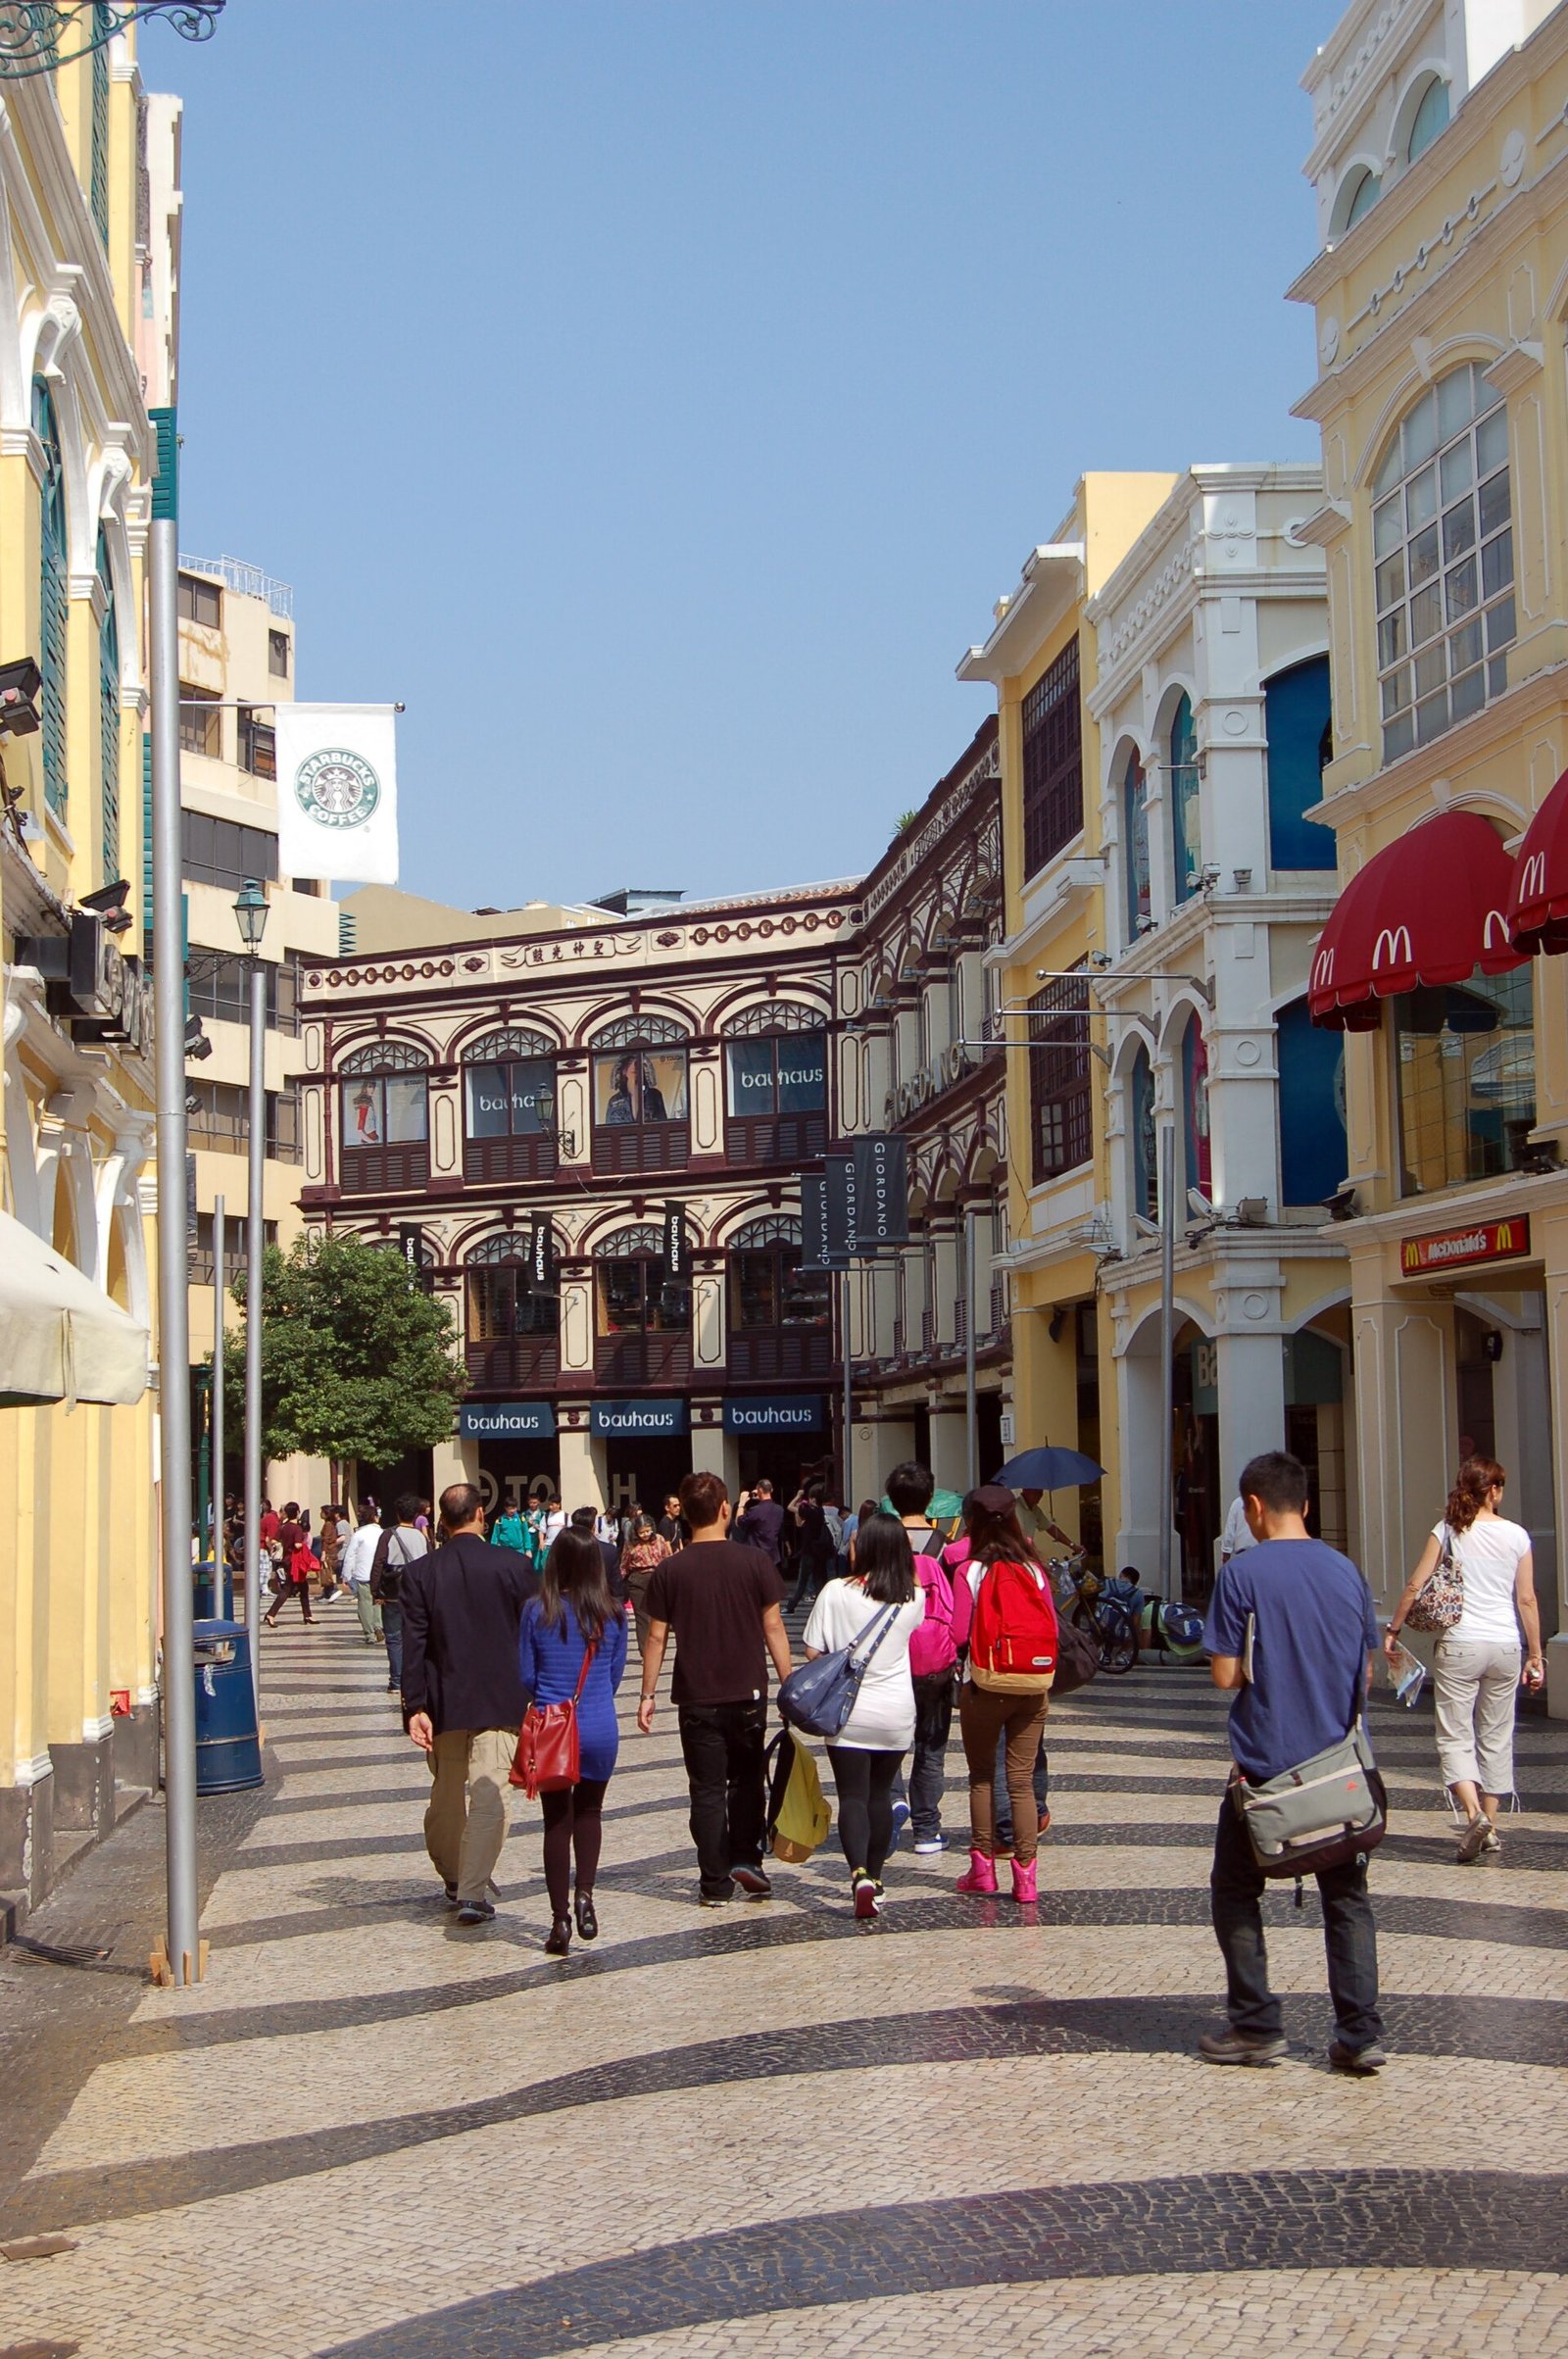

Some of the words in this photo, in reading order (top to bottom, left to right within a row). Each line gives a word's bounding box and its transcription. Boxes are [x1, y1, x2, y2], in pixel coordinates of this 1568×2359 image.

[300, 752, 375, 786] STARBUCKS
[308, 804, 372, 827] COFFEE
[741, 1067, 824, 1089] bauhaus
[874, 1142, 887, 1237] GIORDANO
[1427, 1229, 1488, 1261] McDonald's
[466, 1413, 539, 1430] bauhaus
[598, 1409, 674, 1428] bauhaus
[732, 1405, 812, 1425] bauhaus
